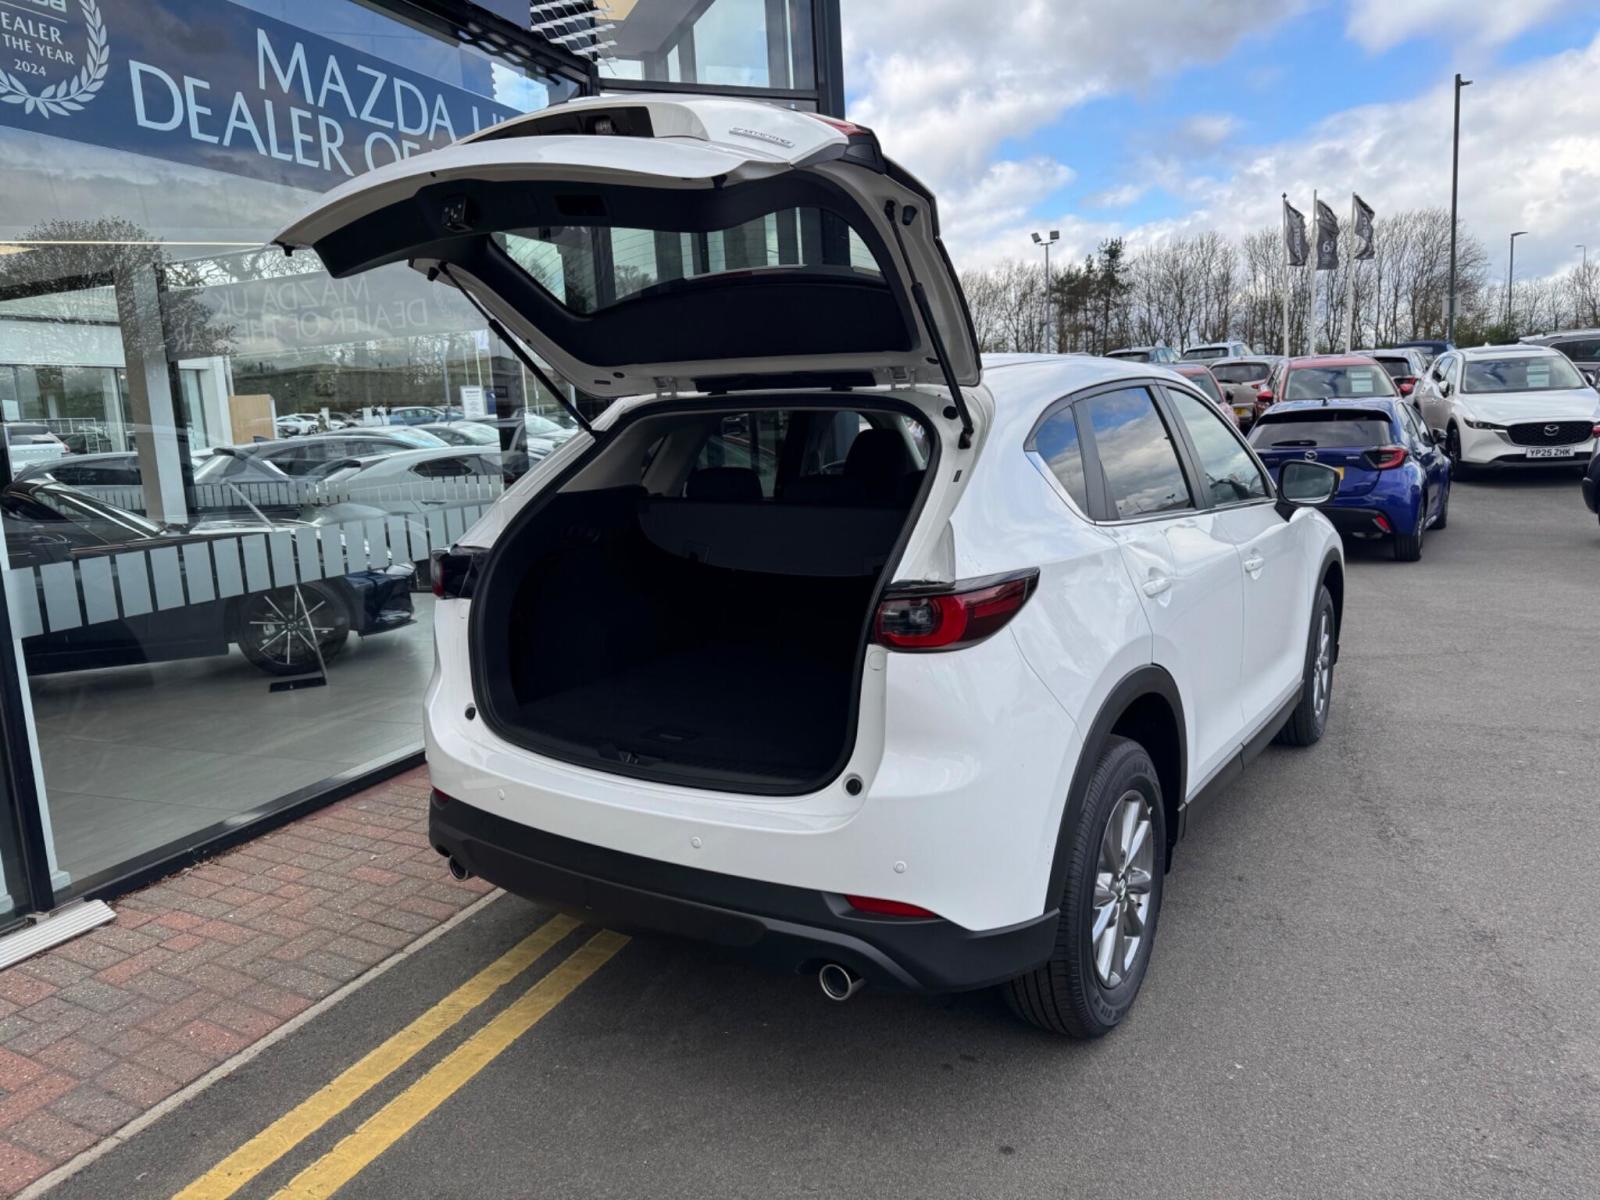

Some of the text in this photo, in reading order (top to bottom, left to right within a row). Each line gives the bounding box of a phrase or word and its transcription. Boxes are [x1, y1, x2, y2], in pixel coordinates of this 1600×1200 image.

[2, 33, 76, 65] THE YEAR
[14, 58, 47, 77] 2024
[256, 27, 457, 144] MAZDA
[128, 59, 355, 176] DEALER
